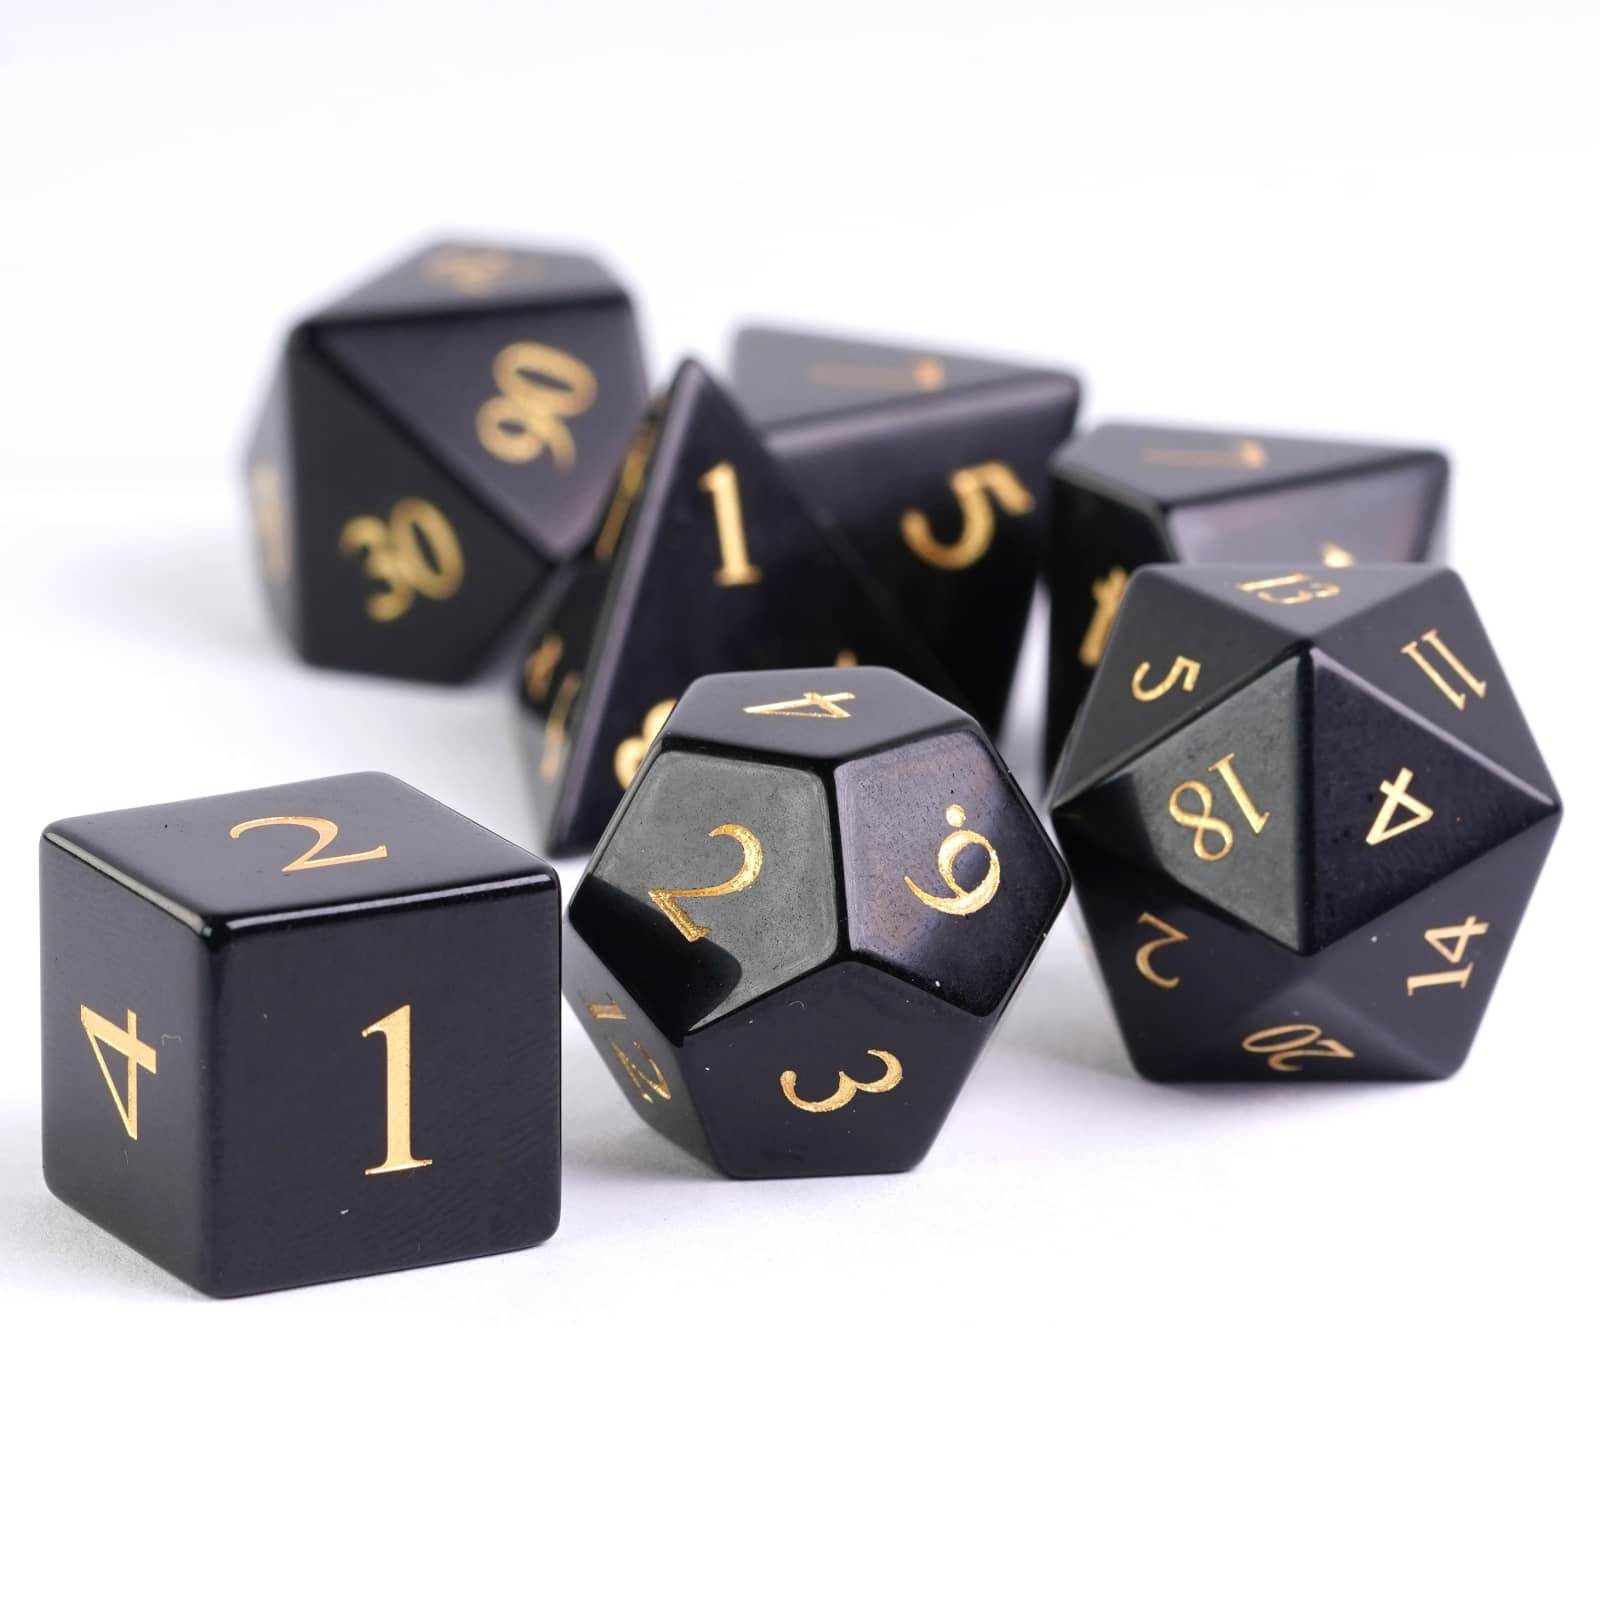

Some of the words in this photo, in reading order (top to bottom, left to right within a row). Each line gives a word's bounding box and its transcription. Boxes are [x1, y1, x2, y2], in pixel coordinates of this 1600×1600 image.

[698, 460, 765, 588] 1
[902, 460, 1034, 570] 5
[339, 497, 464, 622] 30
[743, 691, 857, 720] 4
[1131, 655, 1201, 702] 5
[1401, 628, 1488, 711] 11
[230, 815, 389, 873] 2
[1168, 752, 1271, 861] 18
[1365, 767, 1434, 846] 4
[648, 822, 764, 943] 2
[1135, 911, 1190, 989] 2
[1407, 915, 1490, 997] 14
[80, 1004, 158, 1141] 4
[780, 1048, 904, 1113] 3
[1241, 1023, 1356, 1072] 20
[361, 1004, 433, 1175] 1
